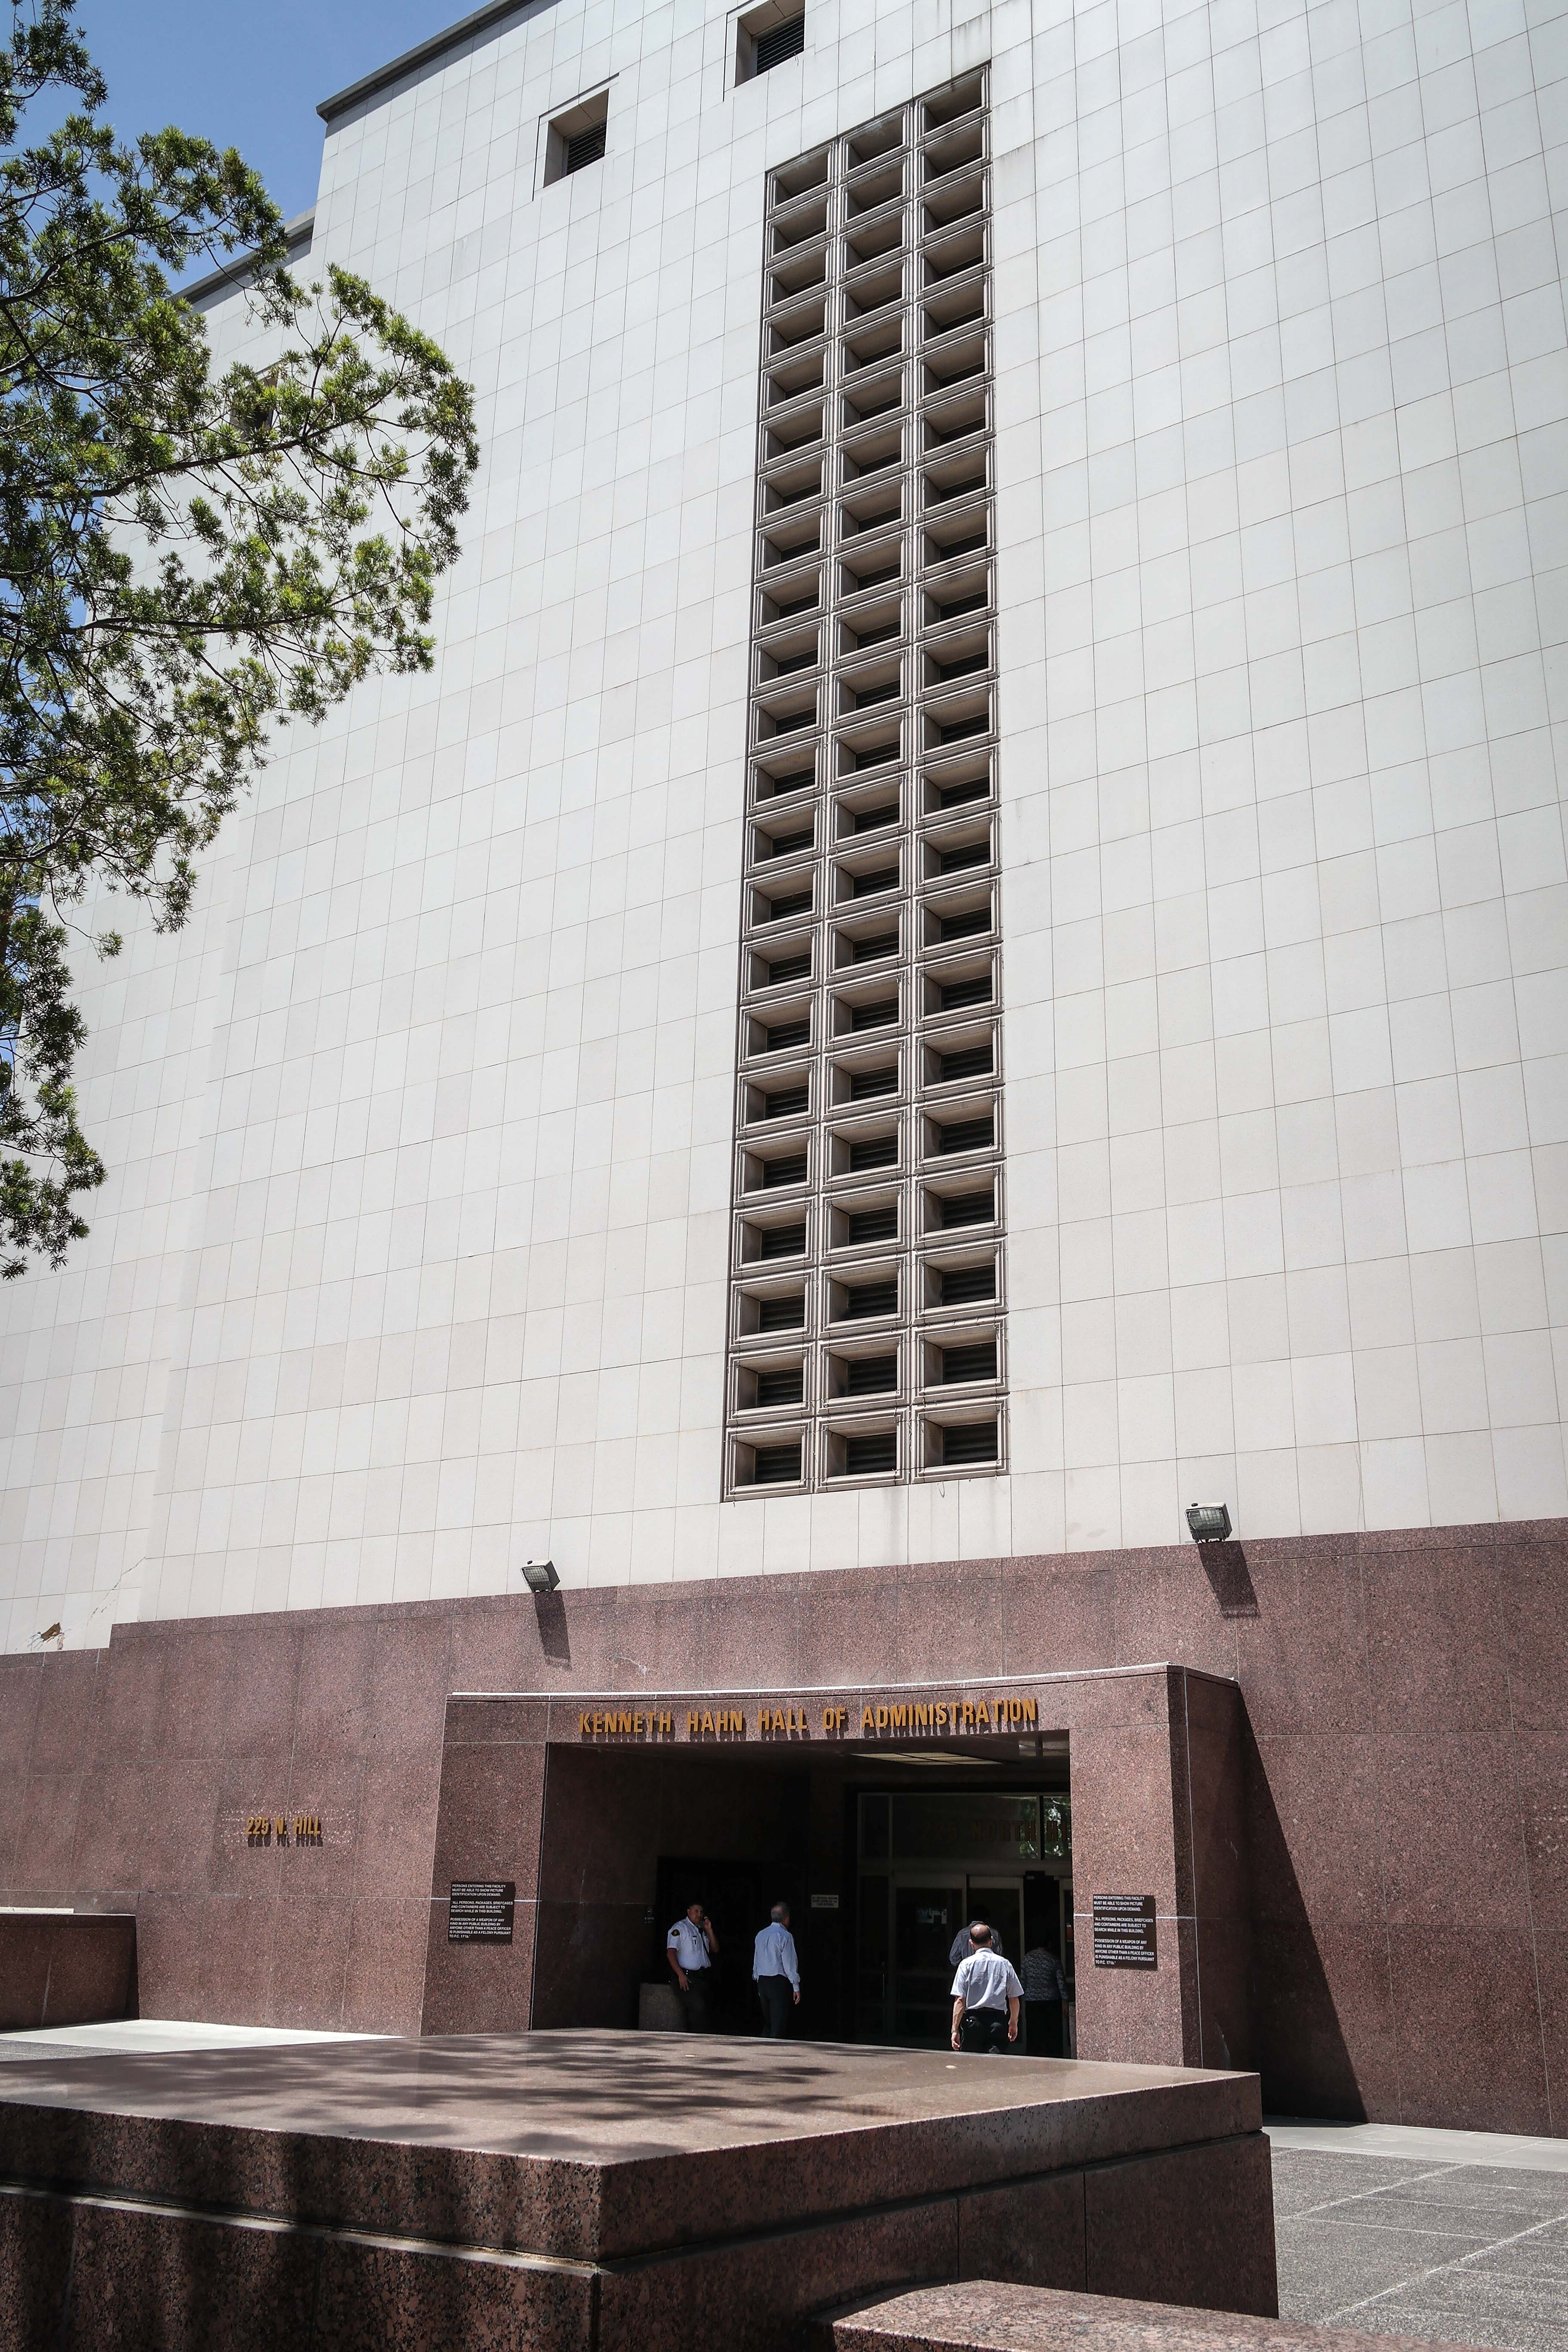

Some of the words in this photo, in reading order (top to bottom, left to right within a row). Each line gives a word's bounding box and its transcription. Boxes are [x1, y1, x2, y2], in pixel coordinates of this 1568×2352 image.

[579, 1711, 671, 1733] KENNETH
[688, 1711, 743, 1732] HAHN
[758, 1708, 808, 1730] HALL
[822, 1707, 846, 1729] OF
[861, 1698, 1036, 1728] ADMINISTRATION
[245, 1816, 270, 1835] 225
[274, 1816, 287, 1835] N.
[294, 1816, 321, 1835] HILL
[921, 1821, 959, 1841] 225
[972, 1820, 1036, 1841] NORTH
